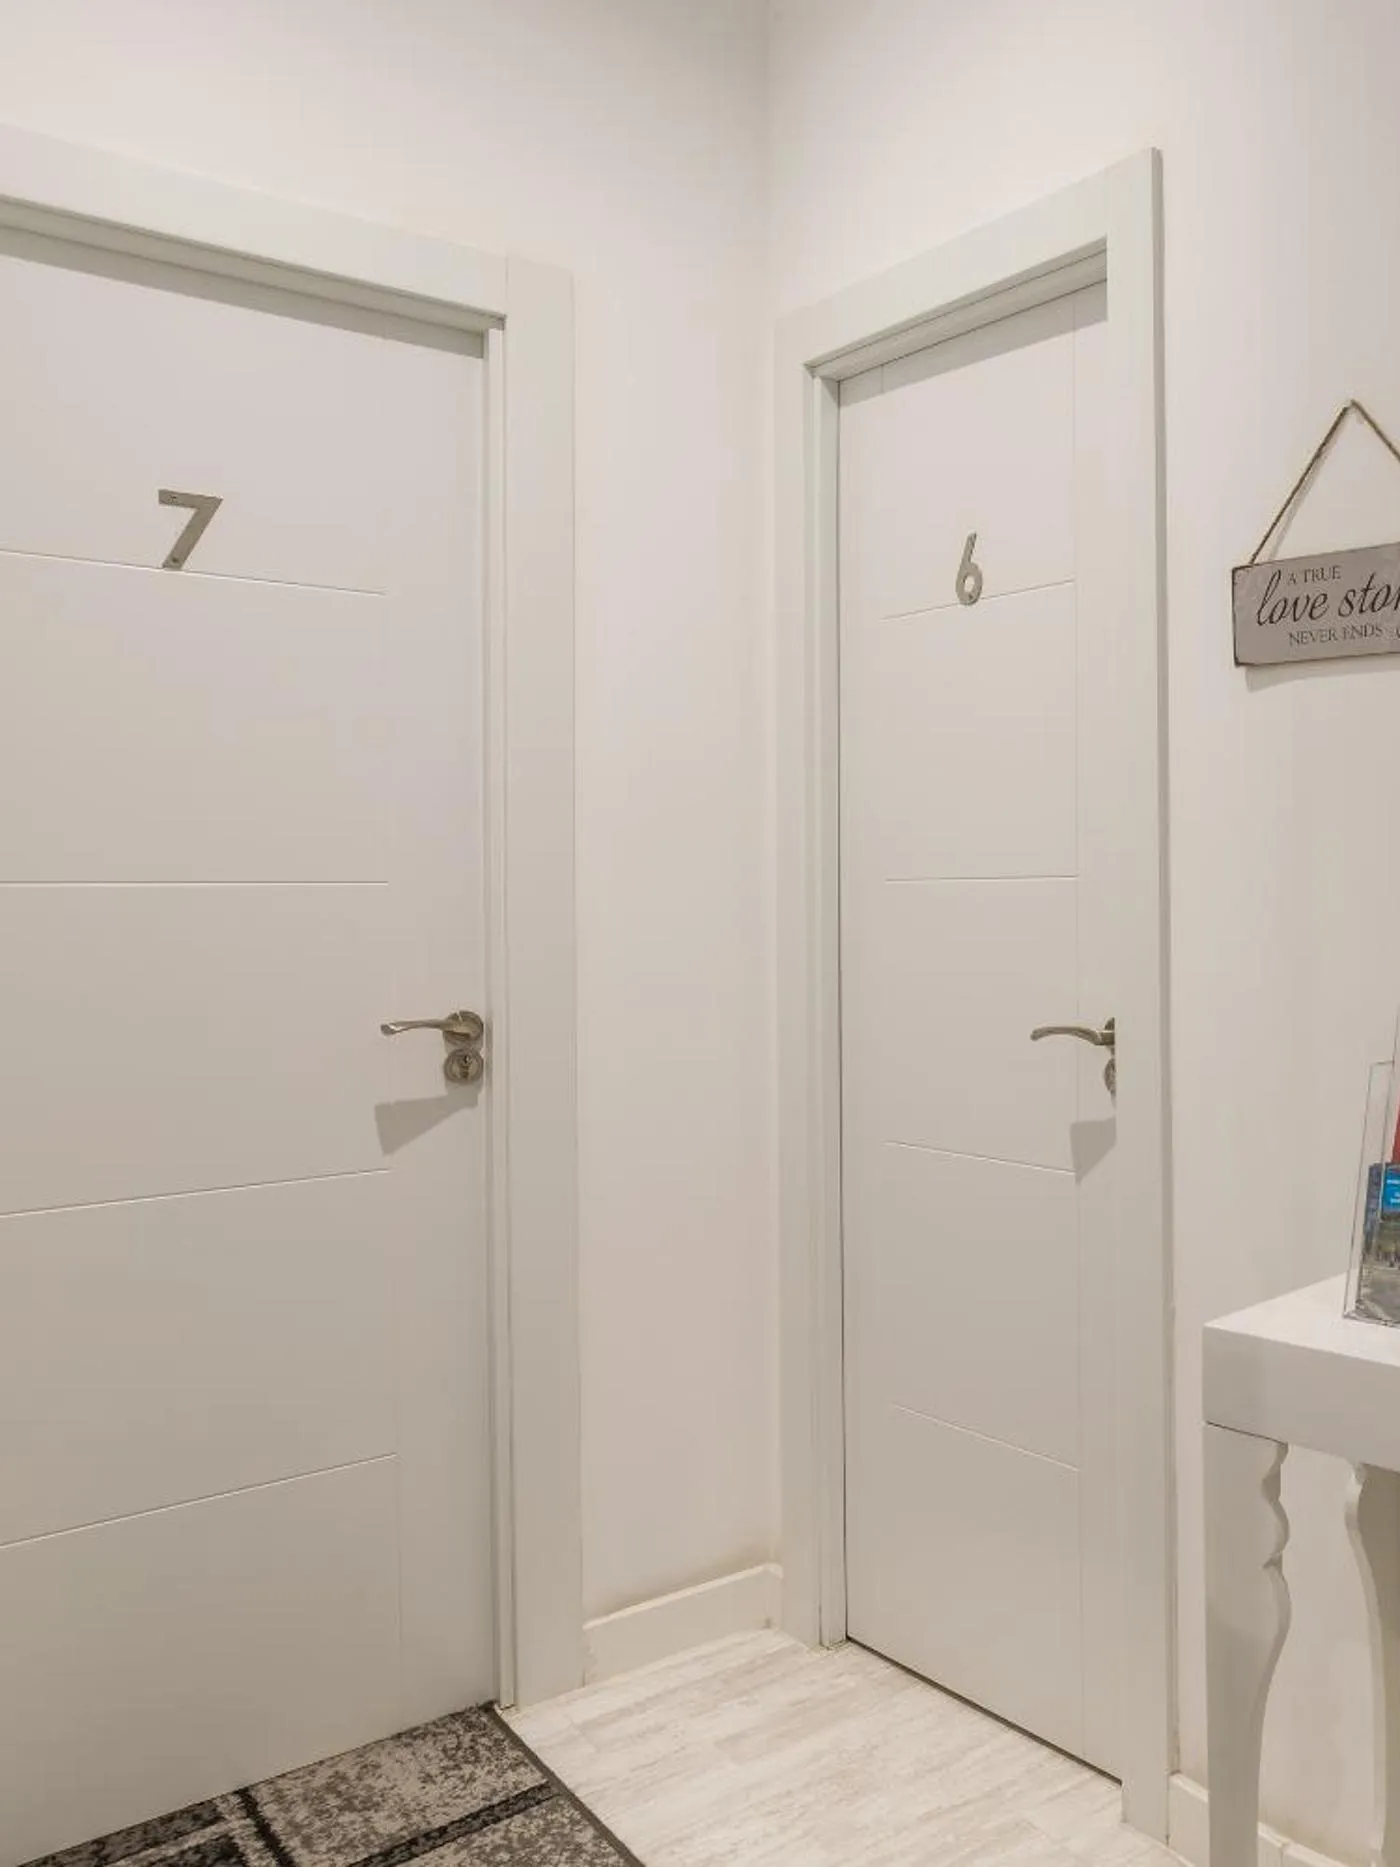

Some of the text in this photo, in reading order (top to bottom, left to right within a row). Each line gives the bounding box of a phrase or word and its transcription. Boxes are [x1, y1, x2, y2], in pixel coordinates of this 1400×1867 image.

[157, 488, 225, 572] 7
[954, 529, 984, 607] 6
[1287, 565, 1343, 585] A TRUE
[1256, 570, 1330, 627] love
[1288, 622, 1384, 646] NEVER ENDS
